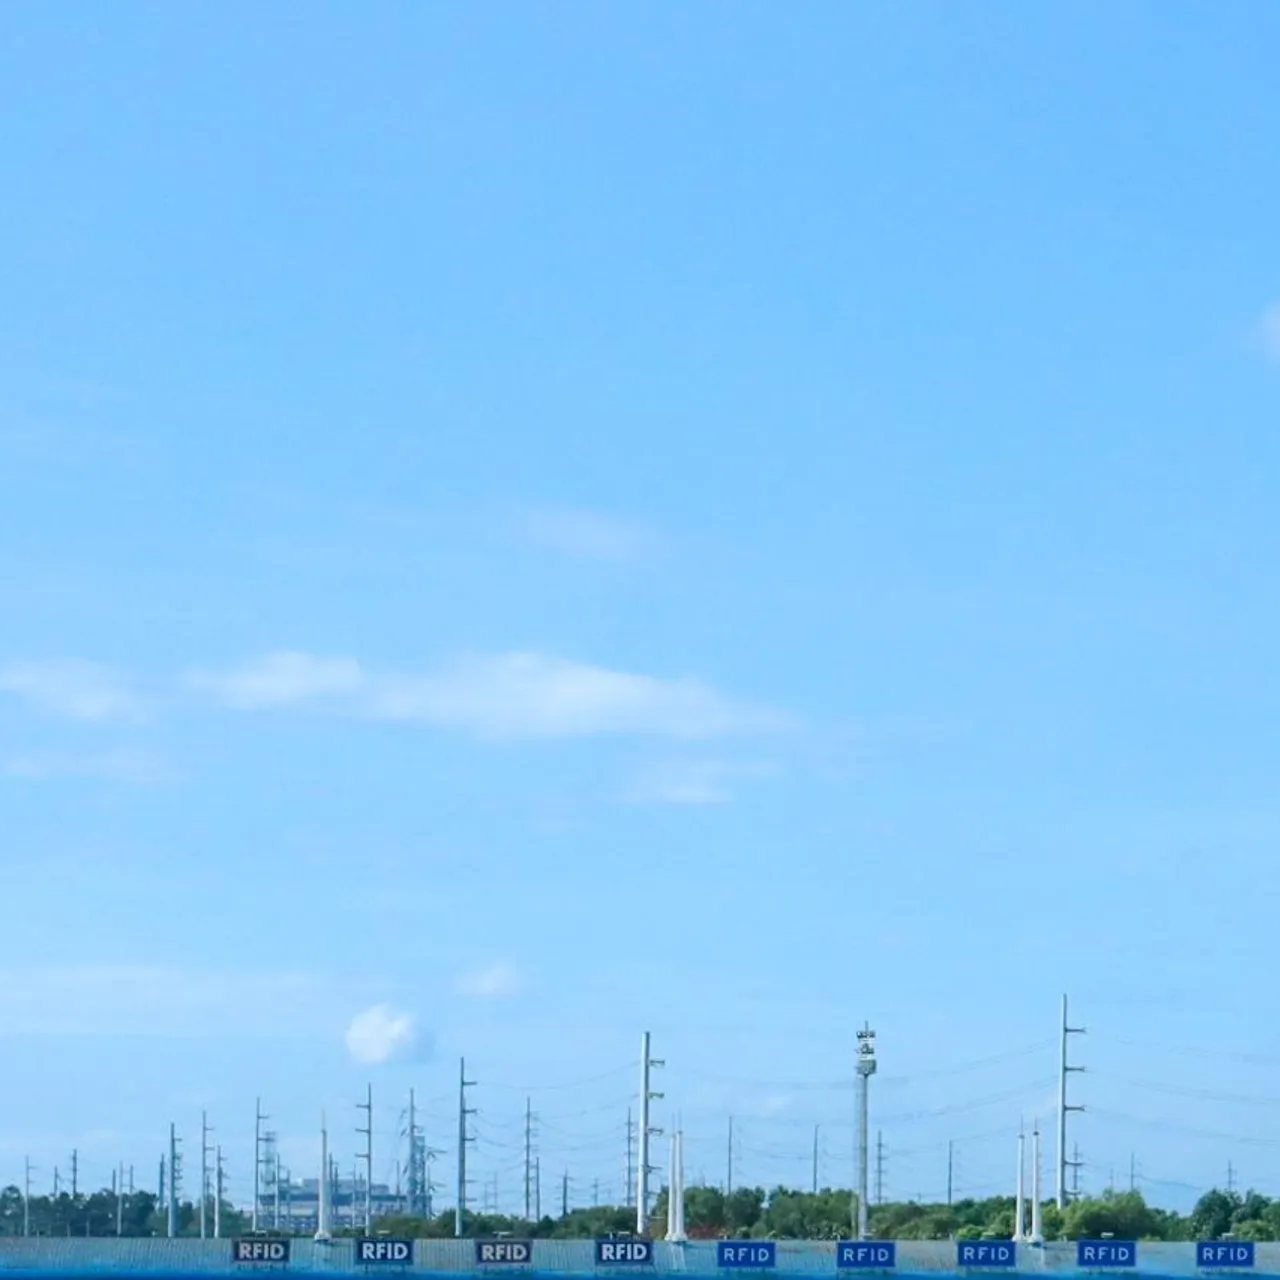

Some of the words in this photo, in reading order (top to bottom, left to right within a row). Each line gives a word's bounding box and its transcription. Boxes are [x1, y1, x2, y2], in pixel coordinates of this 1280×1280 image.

[239, 1243, 285, 1260] RFID
[362, 1243, 408, 1260] RFID
[482, 1244, 527, 1260] RFID
[601, 1243, 647, 1260] RFID
[723, 1247, 769, 1262] RFID
[843, 1248, 889, 1262] RFID
[963, 1246, 1009, 1261] RFID
[1084, 1246, 1129, 1261] RFID
[1202, 1247, 1248, 1261] RFID
